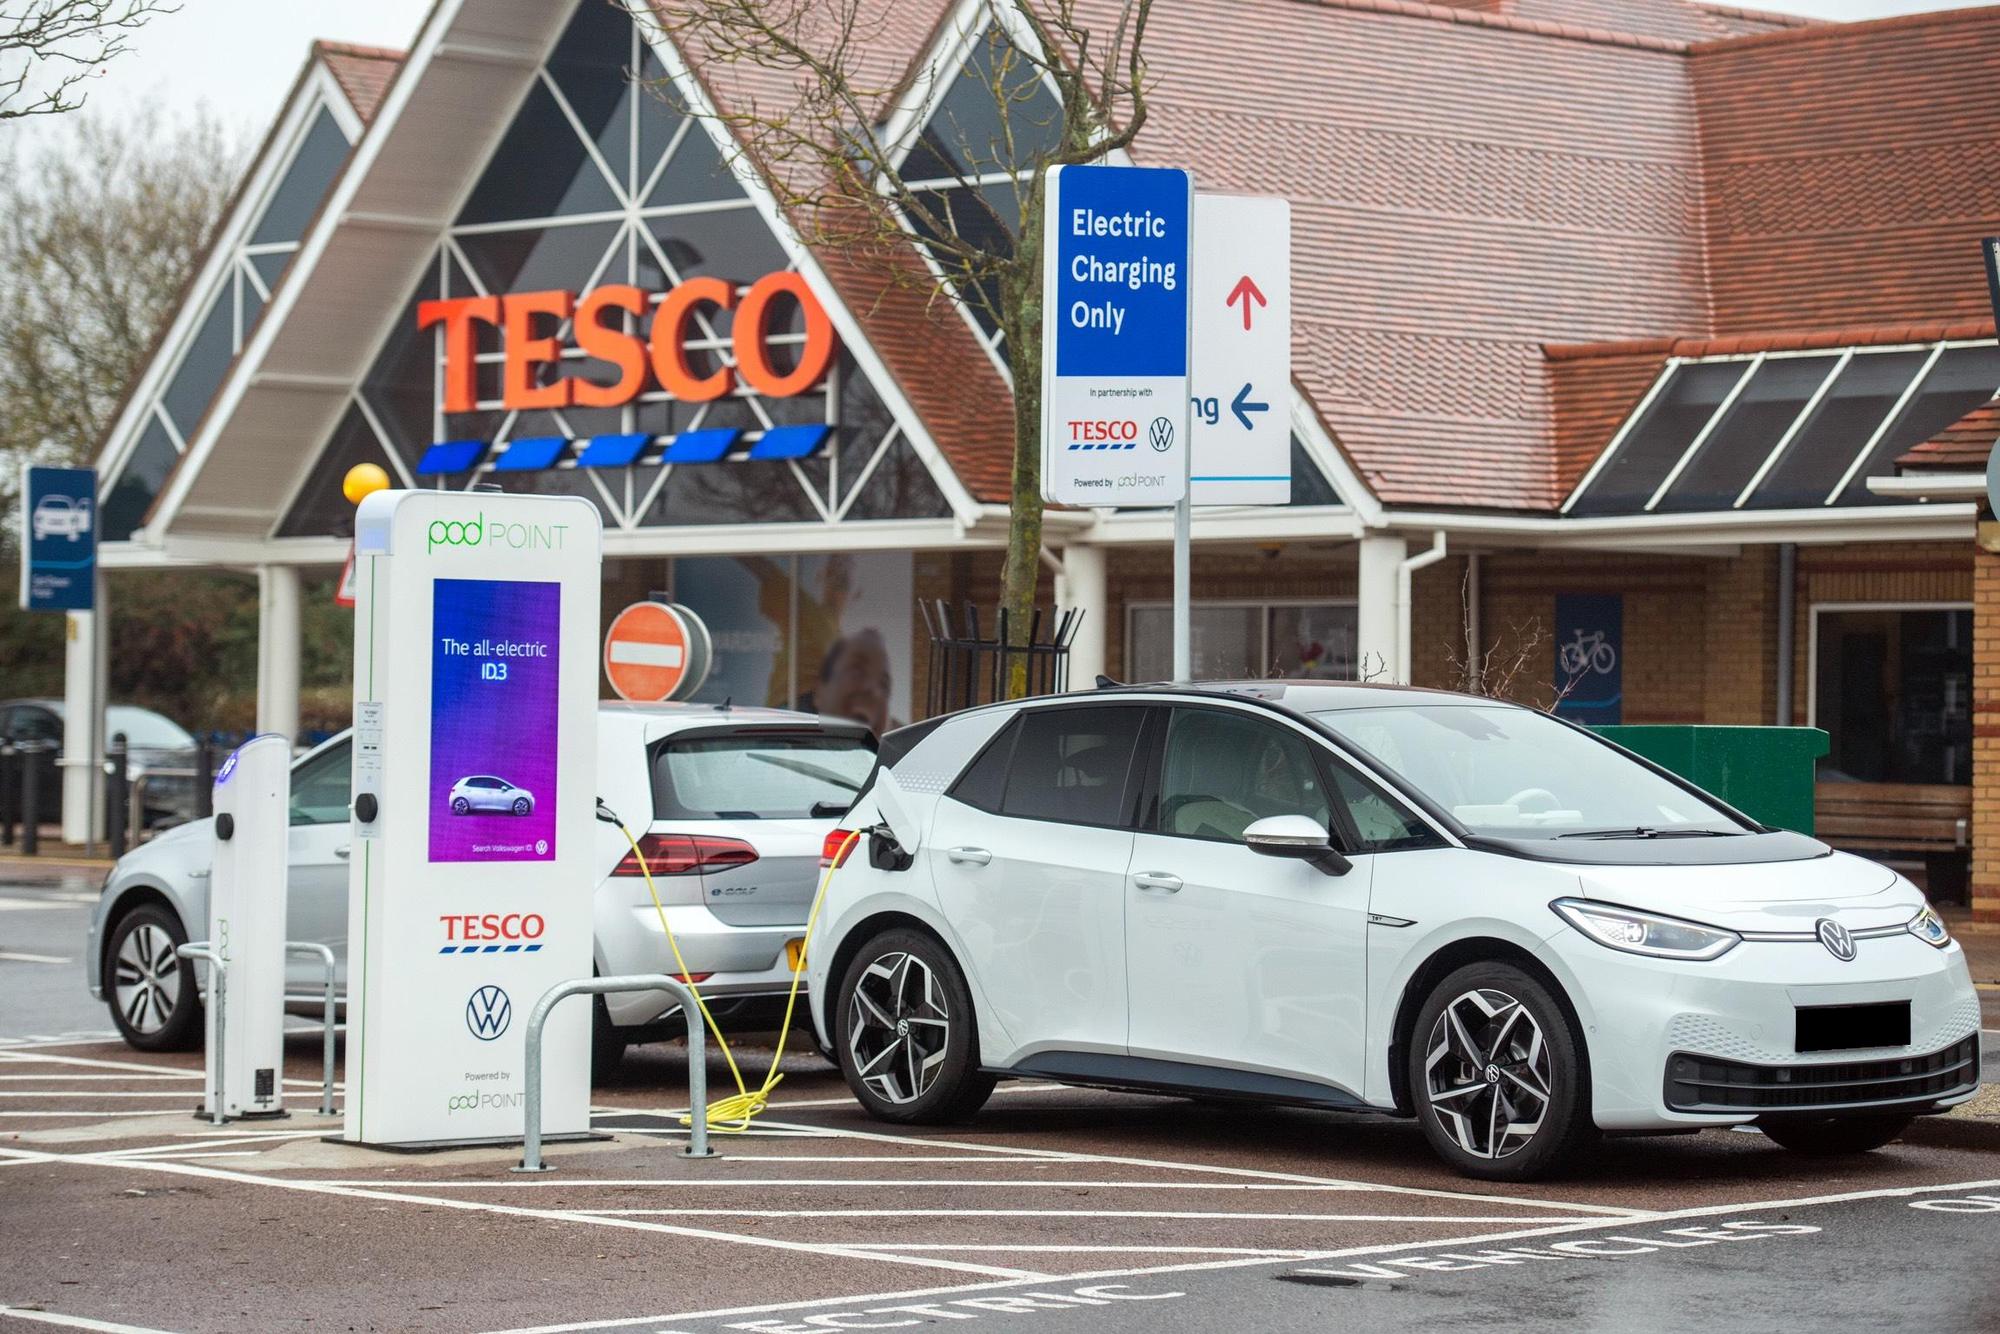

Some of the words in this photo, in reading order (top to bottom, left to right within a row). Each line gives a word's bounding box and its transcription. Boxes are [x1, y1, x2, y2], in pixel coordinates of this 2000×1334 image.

[1072, 209, 1166, 238] Electric
[1071, 255, 1176, 290] Charging
[1071, 301, 1125, 335] Only
[417, 271, 838, 413] TESCO
[1089, 388, 1097, 396] In
[1098, 388, 1138, 398] partnership
[1139, 388, 1153, 397] with
[1067, 420, 1137, 441] TESCO
[1074, 478, 1104, 488] Powered
[1105, 478, 1113, 488] by
[1138, 475, 1166, 487] POINT
[428, 511, 482, 555] pod
[489, 522, 569, 549] POINT
[442, 638, 469, 655] The
[473, 639, 547, 657] all-electric
[472, 844, 490, 853] Search
[491, 844, 525, 854] Volkswagen
[439, 913, 545, 940] TESCO
[464, 1071, 499, 1081] Powered
[501, 1071, 511, 1081] by
[448, 1089, 479, 1116] pod
[481, 1092, 526, 1109] POINT
[655, 1285, 1187, 1334] ECTRIC
[1295, 1221, 1823, 1279] VEHICLES
